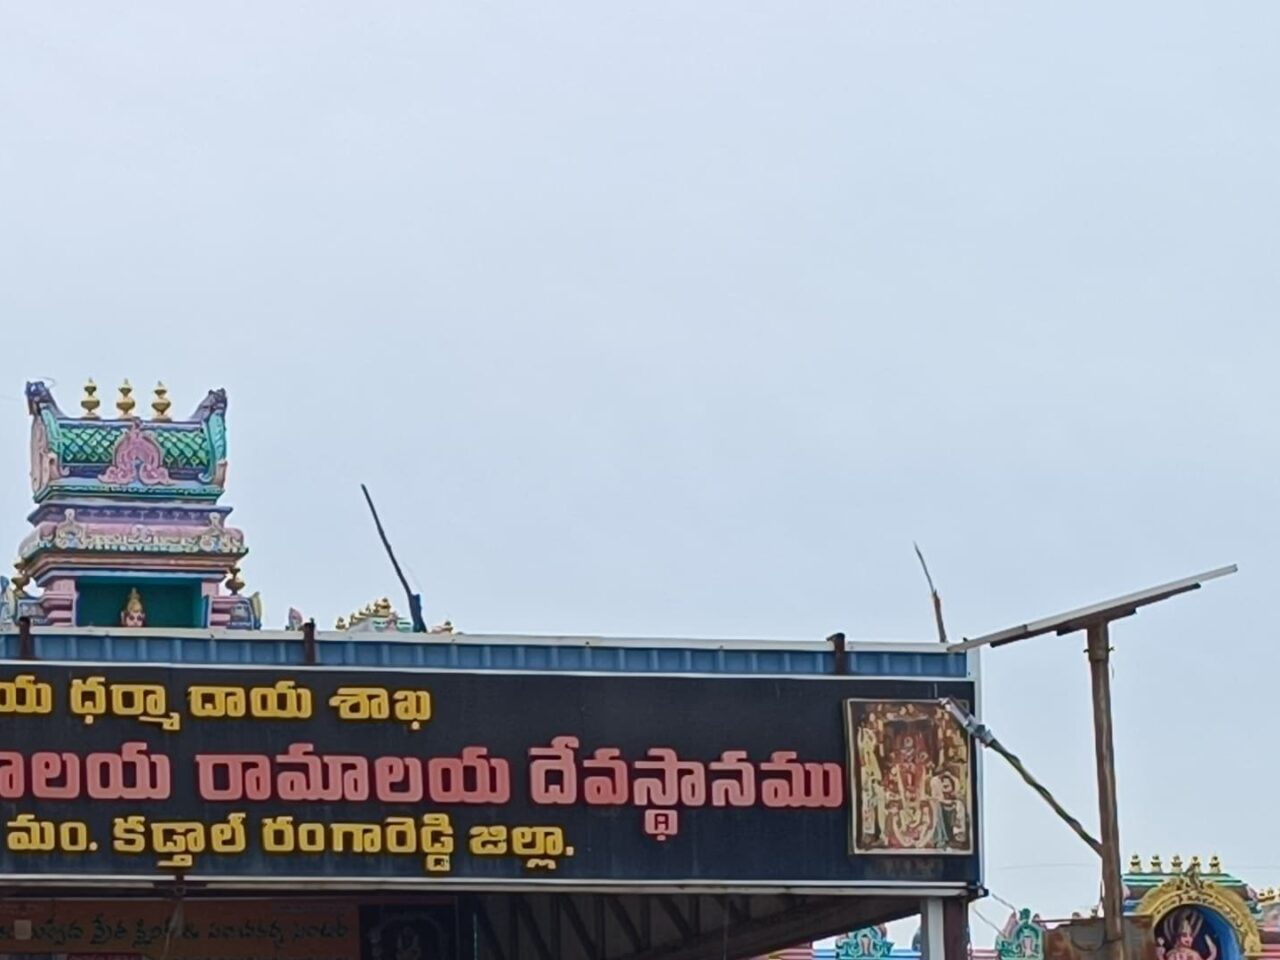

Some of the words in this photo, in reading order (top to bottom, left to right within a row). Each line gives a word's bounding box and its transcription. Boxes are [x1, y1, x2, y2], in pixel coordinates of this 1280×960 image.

[70, 676, 181, 731] ధర్మా
[187, 680, 313, 719] దాయ
[328, 686, 432, 730] శాఖ
[195, 742, 511, 805] రామాలయ
[528, 735, 845, 841] దేవస్థానము
[6, 813, 99, 852] మం.
[111, 812, 248, 868] కడ్తాల్
[260, 811, 455, 873] రంగారెడ్డి
[468, 824, 575, 871] జిల్లా.
